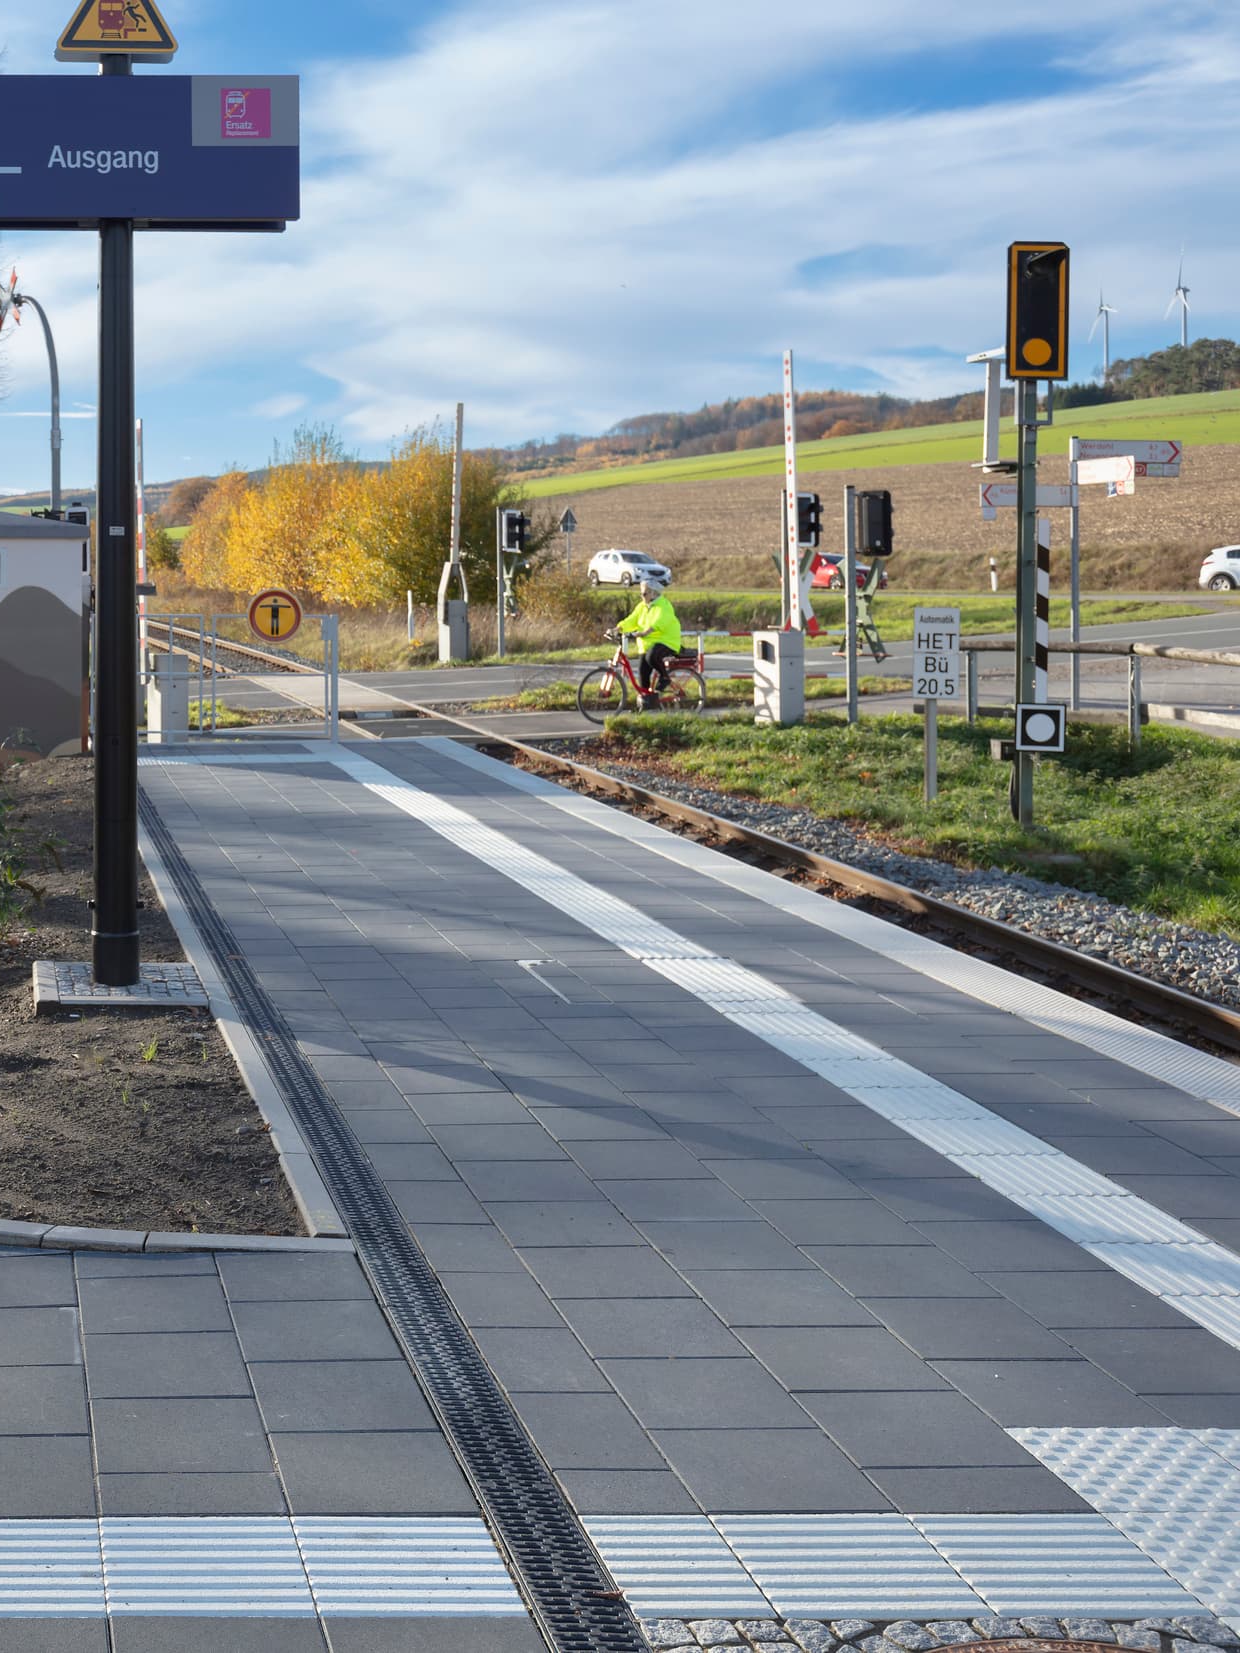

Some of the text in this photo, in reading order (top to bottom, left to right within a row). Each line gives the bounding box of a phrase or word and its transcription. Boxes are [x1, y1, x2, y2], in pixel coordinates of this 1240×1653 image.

[225, 120, 253, 130] Ersatz
[48, 145, 159, 174] Ausgang
[920, 615, 954, 624] Automatik
[918, 633, 957, 650] HET
[924, 656, 949, 673] Bü
[917, 678, 954, 696] 20.5
